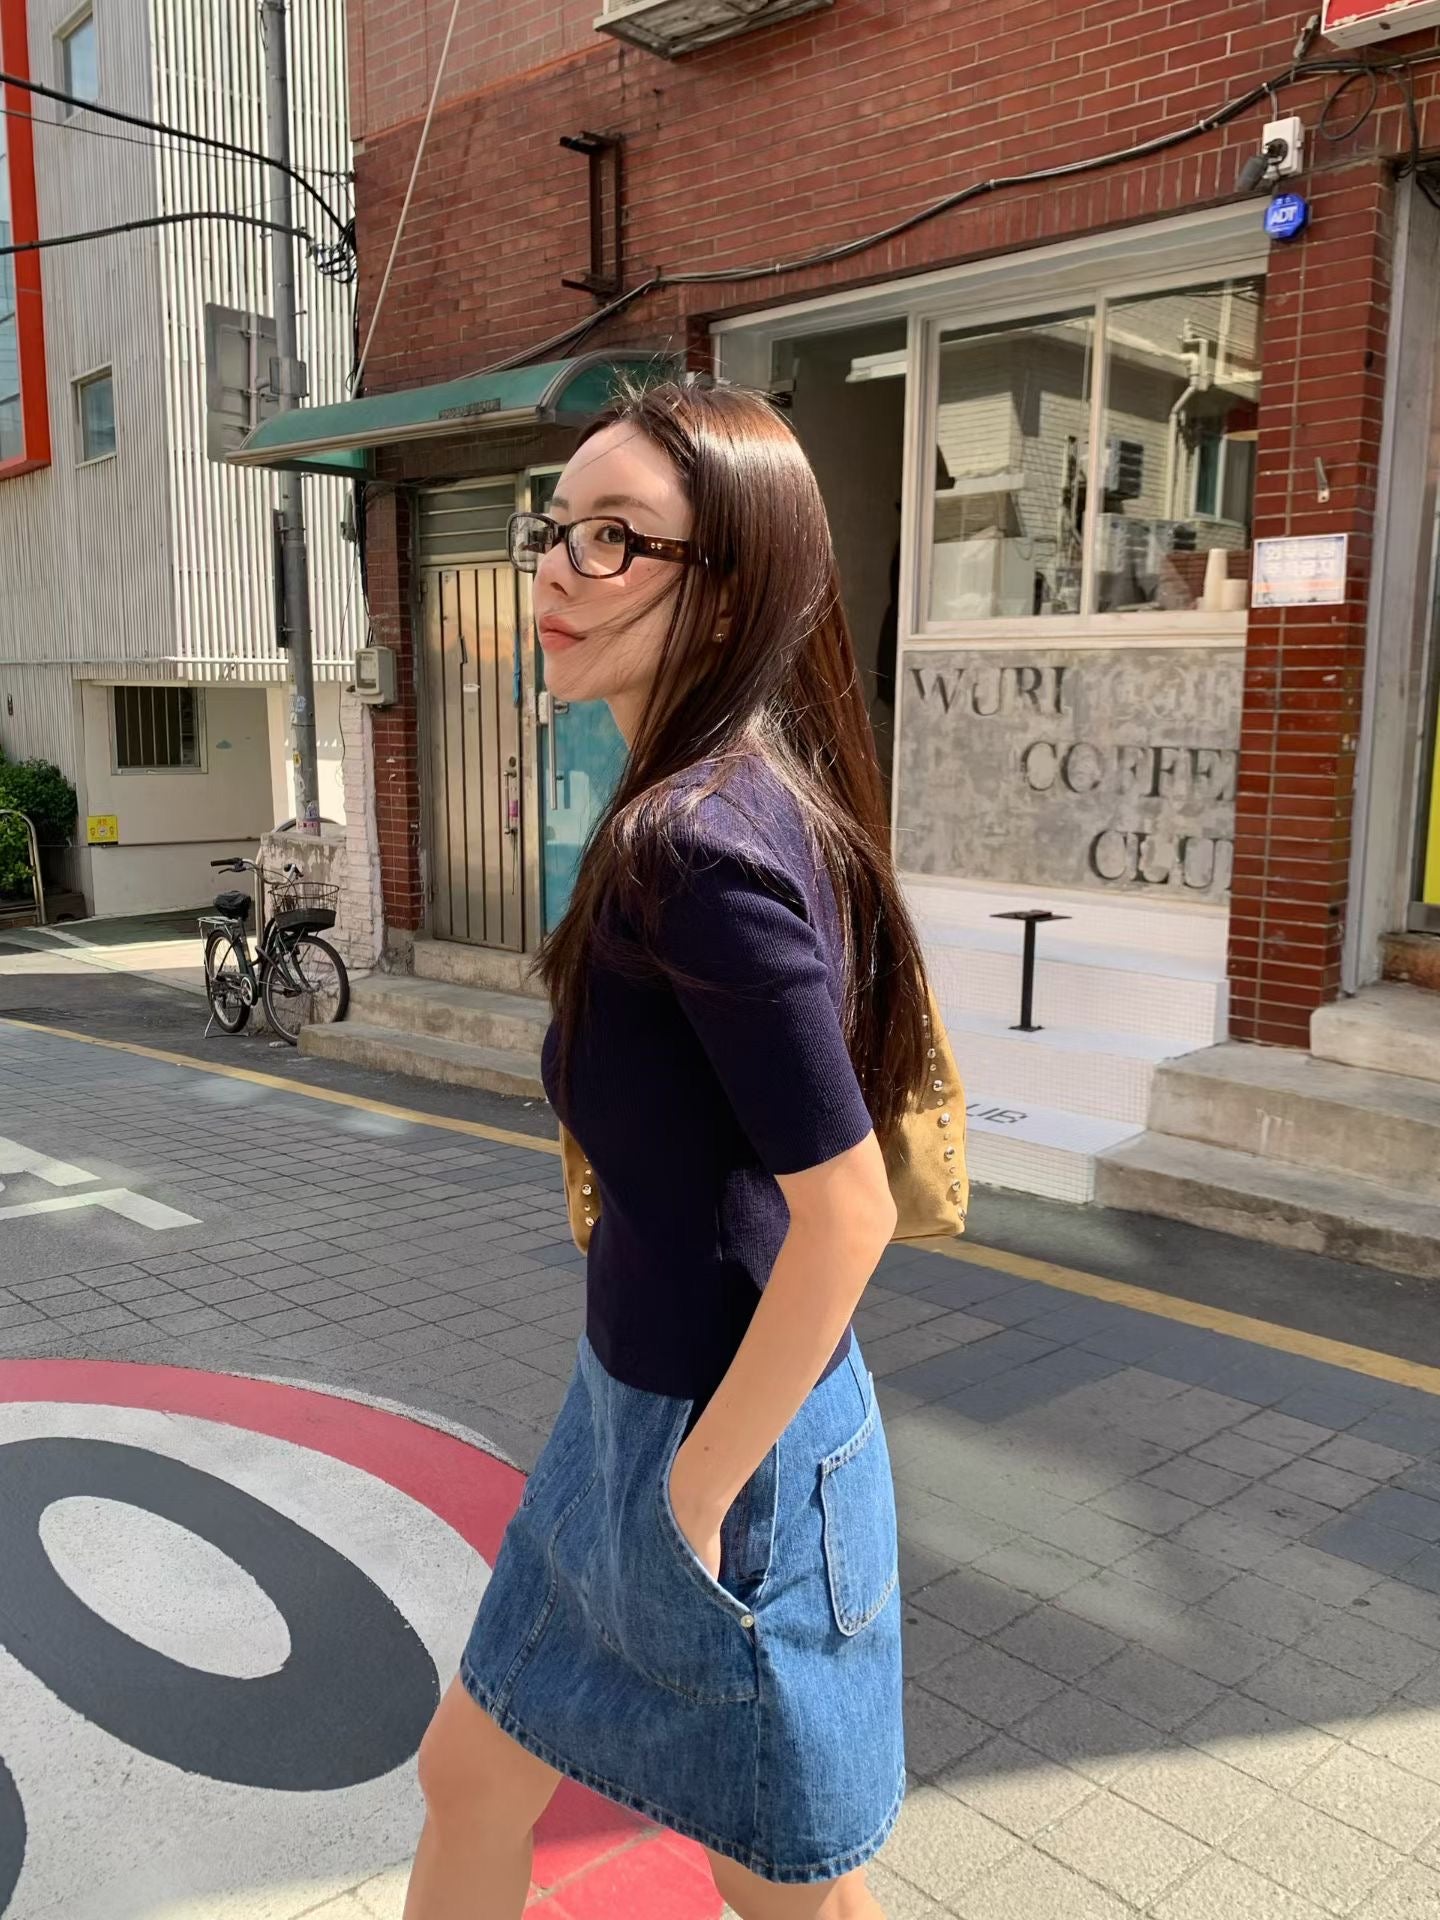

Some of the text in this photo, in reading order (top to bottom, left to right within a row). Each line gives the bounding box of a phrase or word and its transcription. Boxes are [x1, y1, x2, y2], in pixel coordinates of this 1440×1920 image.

[1270, 206, 1298, 224] ADT
[909, 665, 1067, 717] WURI
[1021, 741, 1239, 802] COFFE
